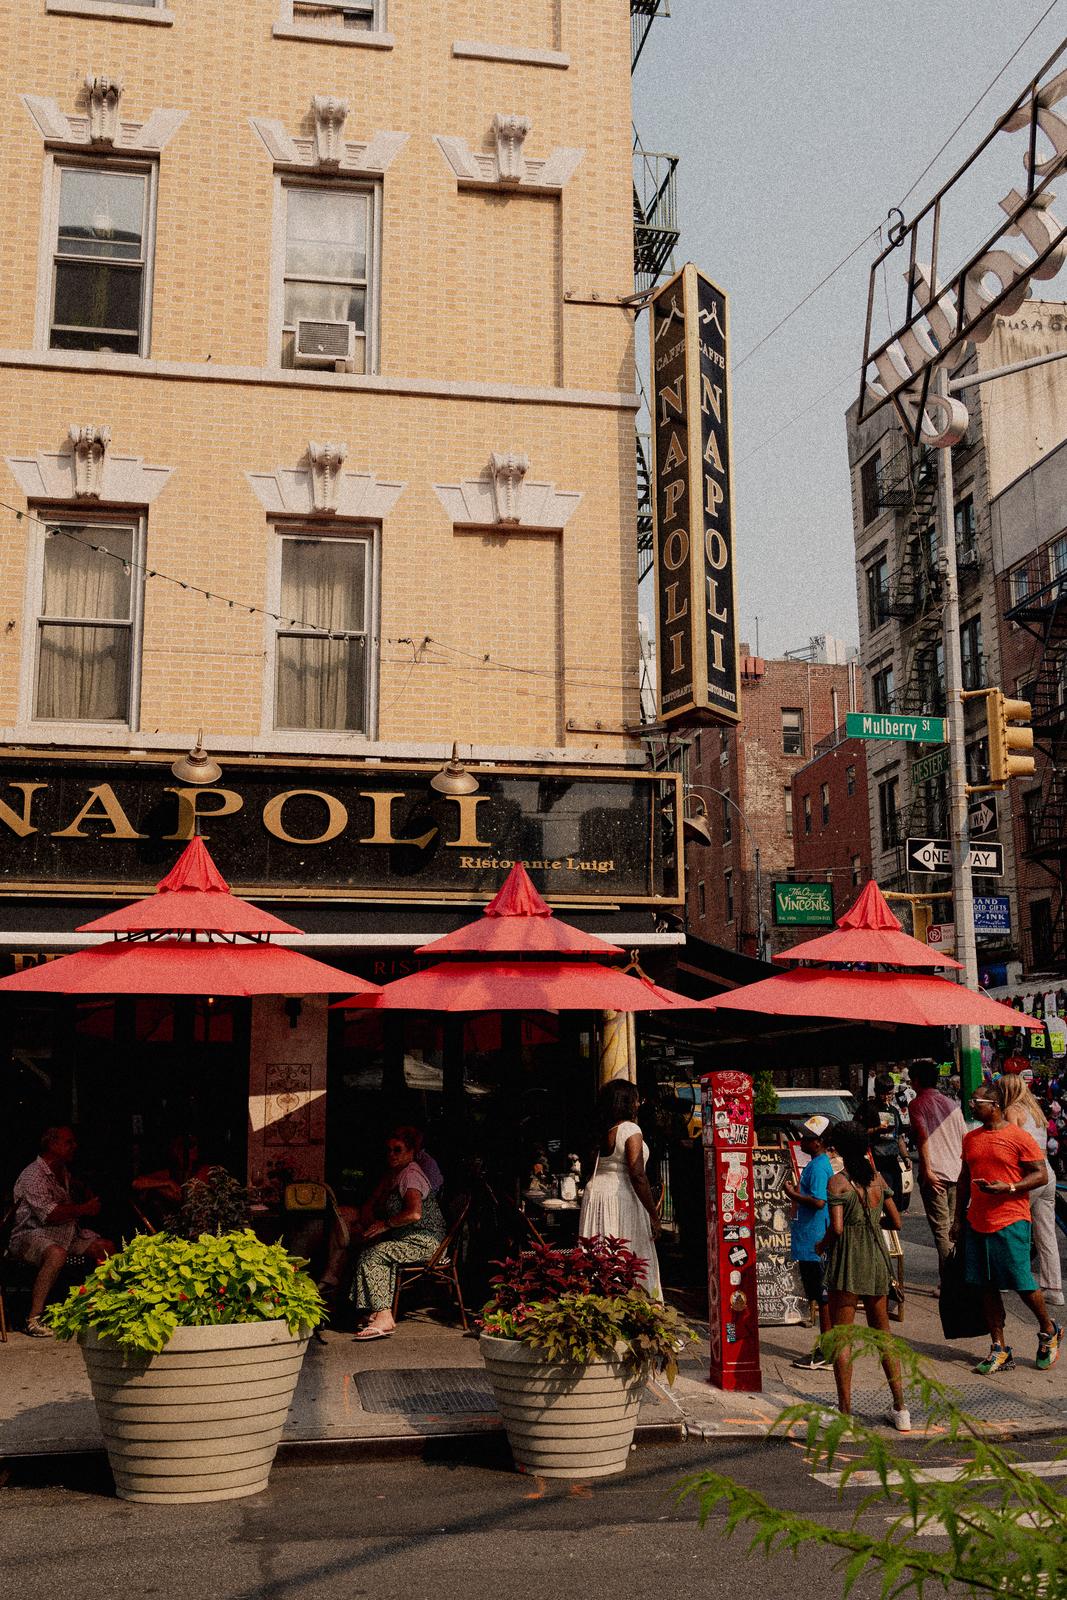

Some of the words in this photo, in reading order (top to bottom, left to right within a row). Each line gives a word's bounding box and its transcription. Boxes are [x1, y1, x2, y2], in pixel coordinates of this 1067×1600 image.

[659, 375, 690, 674] NAPOLI
[701, 373, 728, 673] NAPOLI
[863, 717, 917, 740] Mulberry
[922, 720, 930, 730] St
[913, 754, 943, 782] HESTER
[973, 809, 989, 826] WAY
[566, 858, 615, 872] Luigi
[923, 850, 949, 863] ONE
[969, 853, 990, 865] AY
[758, 1231, 791, 1249] WINE
